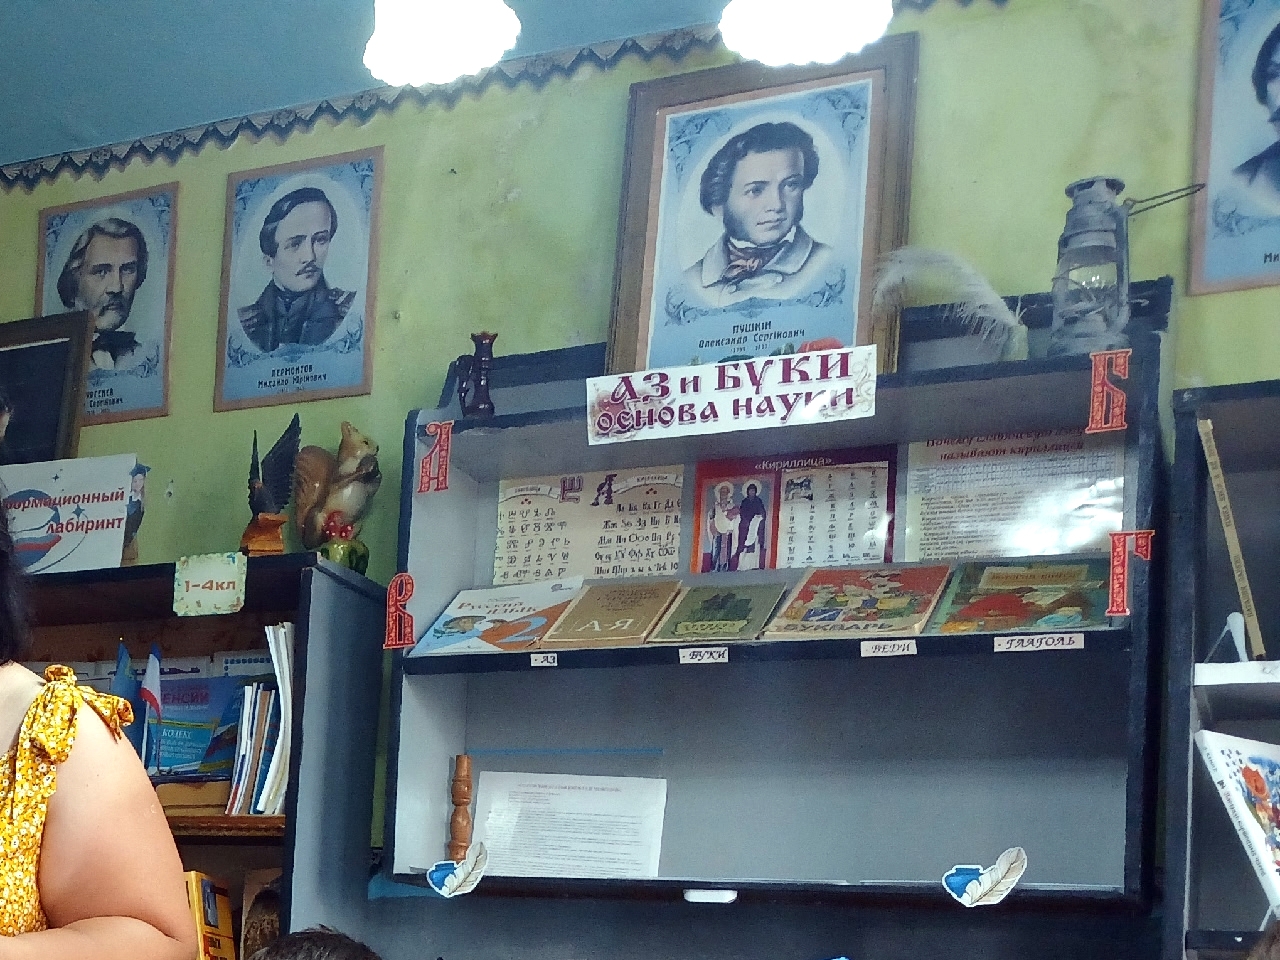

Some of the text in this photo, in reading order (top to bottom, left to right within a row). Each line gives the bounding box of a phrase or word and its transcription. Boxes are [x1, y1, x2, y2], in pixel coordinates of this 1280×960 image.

[610, 350, 854, 404] АЗ и БУКИ
[596, 400, 719, 434] основа
[45, 516, 125, 534] лабиринт
[782, 622, 894, 632] БУКВАРЬ
[1005, 635, 1076, 650] ГЛАГОЛЬ
